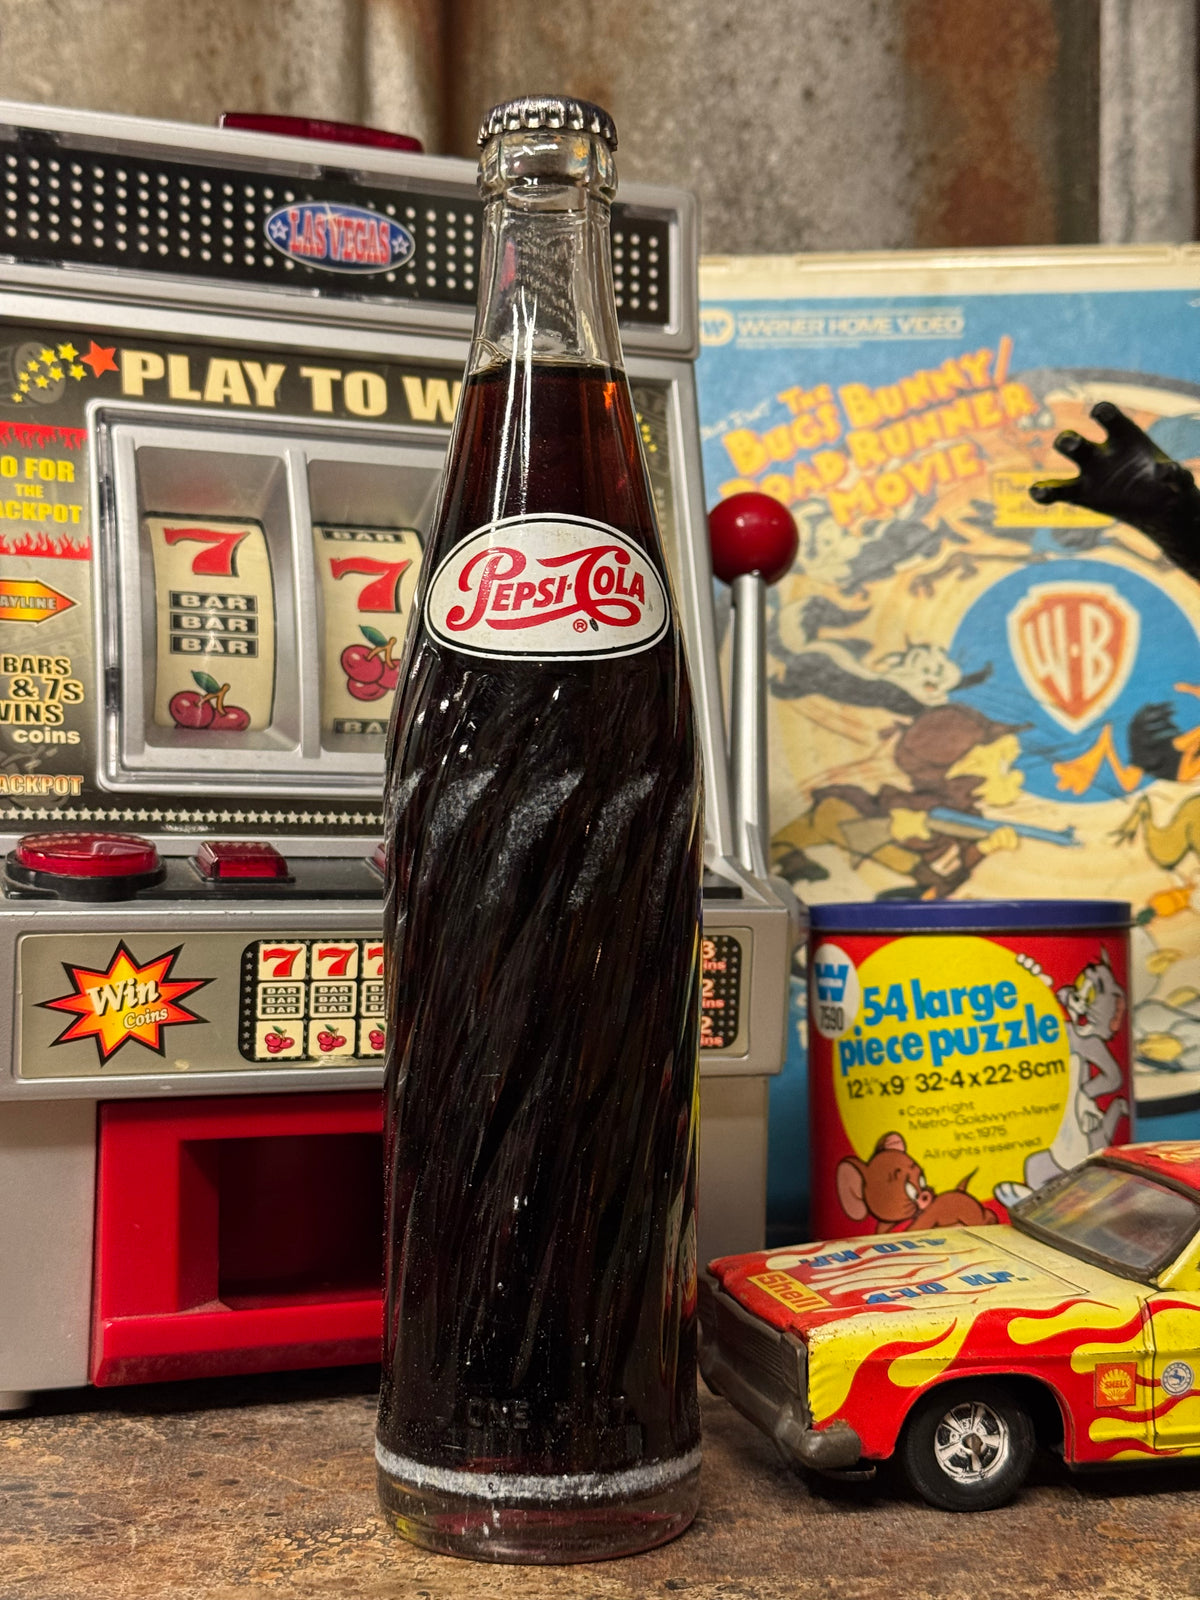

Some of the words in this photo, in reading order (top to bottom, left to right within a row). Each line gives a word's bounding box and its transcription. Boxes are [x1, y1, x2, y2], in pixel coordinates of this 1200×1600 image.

[289, 209, 327, 258] LAS
[329, 216, 391, 266] VEGAS
[737, 318, 824, 337] WARNER
[829, 317, 891, 335] HOME
[897, 315, 965, 334] VIDEO
[120, 349, 286, 408] PLAY
[301, 366, 387, 417] TO
[402, 376, 463, 423] W
[846, 382, 1040, 469] RUNNER
[722, 402, 842, 478] BUGS
[0, 455, 18, 478] O
[24, 457, 75, 483] FOR
[15, 483, 44, 499] THE
[828, 443, 986, 527] MOVIE
[0, 500, 83, 524] CKPOT
[163, 526, 251, 578] 7
[329, 555, 414, 614] 7
[446, 545, 646, 632] PEPSI-COLA
[0, 595, 57, 610] AYLINE
[180, 594, 248, 610] BAR
[181, 615, 248, 631] BAR
[181, 637, 248, 654] BAR
[2, 654, 71, 676] BARS
[11, 677, 38, 699] &
[43, 677, 83, 703] 7S
[13, 727, 81, 745] coins
[344, 720, 383, 734] BA
[0, 775, 84, 796] ACKPOT
[263, 946, 303, 977] 7
[318, 946, 357, 976] 7
[703, 960, 727, 971] ins
[86, 977, 162, 1017] Win
[266, 987, 297, 995] BAR
[320, 986, 349, 994] BAR
[266, 996, 297, 1004] BAR
[320, 995, 349, 1003] BAR
[265, 1006, 297, 1014] BAR
[319, 1005, 349, 1013] BAR
[702, 998, 726, 1009] ins
[863, 983, 909, 1027] 54
[910, 978, 1018, 1022] large
[123, 1007, 168, 1029] Coins
[700, 1036, 724, 1047] ins
[838, 1025, 925, 1077] piece
[928, 1003, 1061, 1068] puzzle
[906, 1101, 976, 1117] Copyright
[909, 1102, 1061, 1130] Metro-Goldwyn-Mayer
[943, 1146, 981, 1161] rights
[983, 1137, 1042, 1153] reserved
[756, 1273, 824, 1309] Shell
[1104, 1379, 1129, 1389] SHELL
